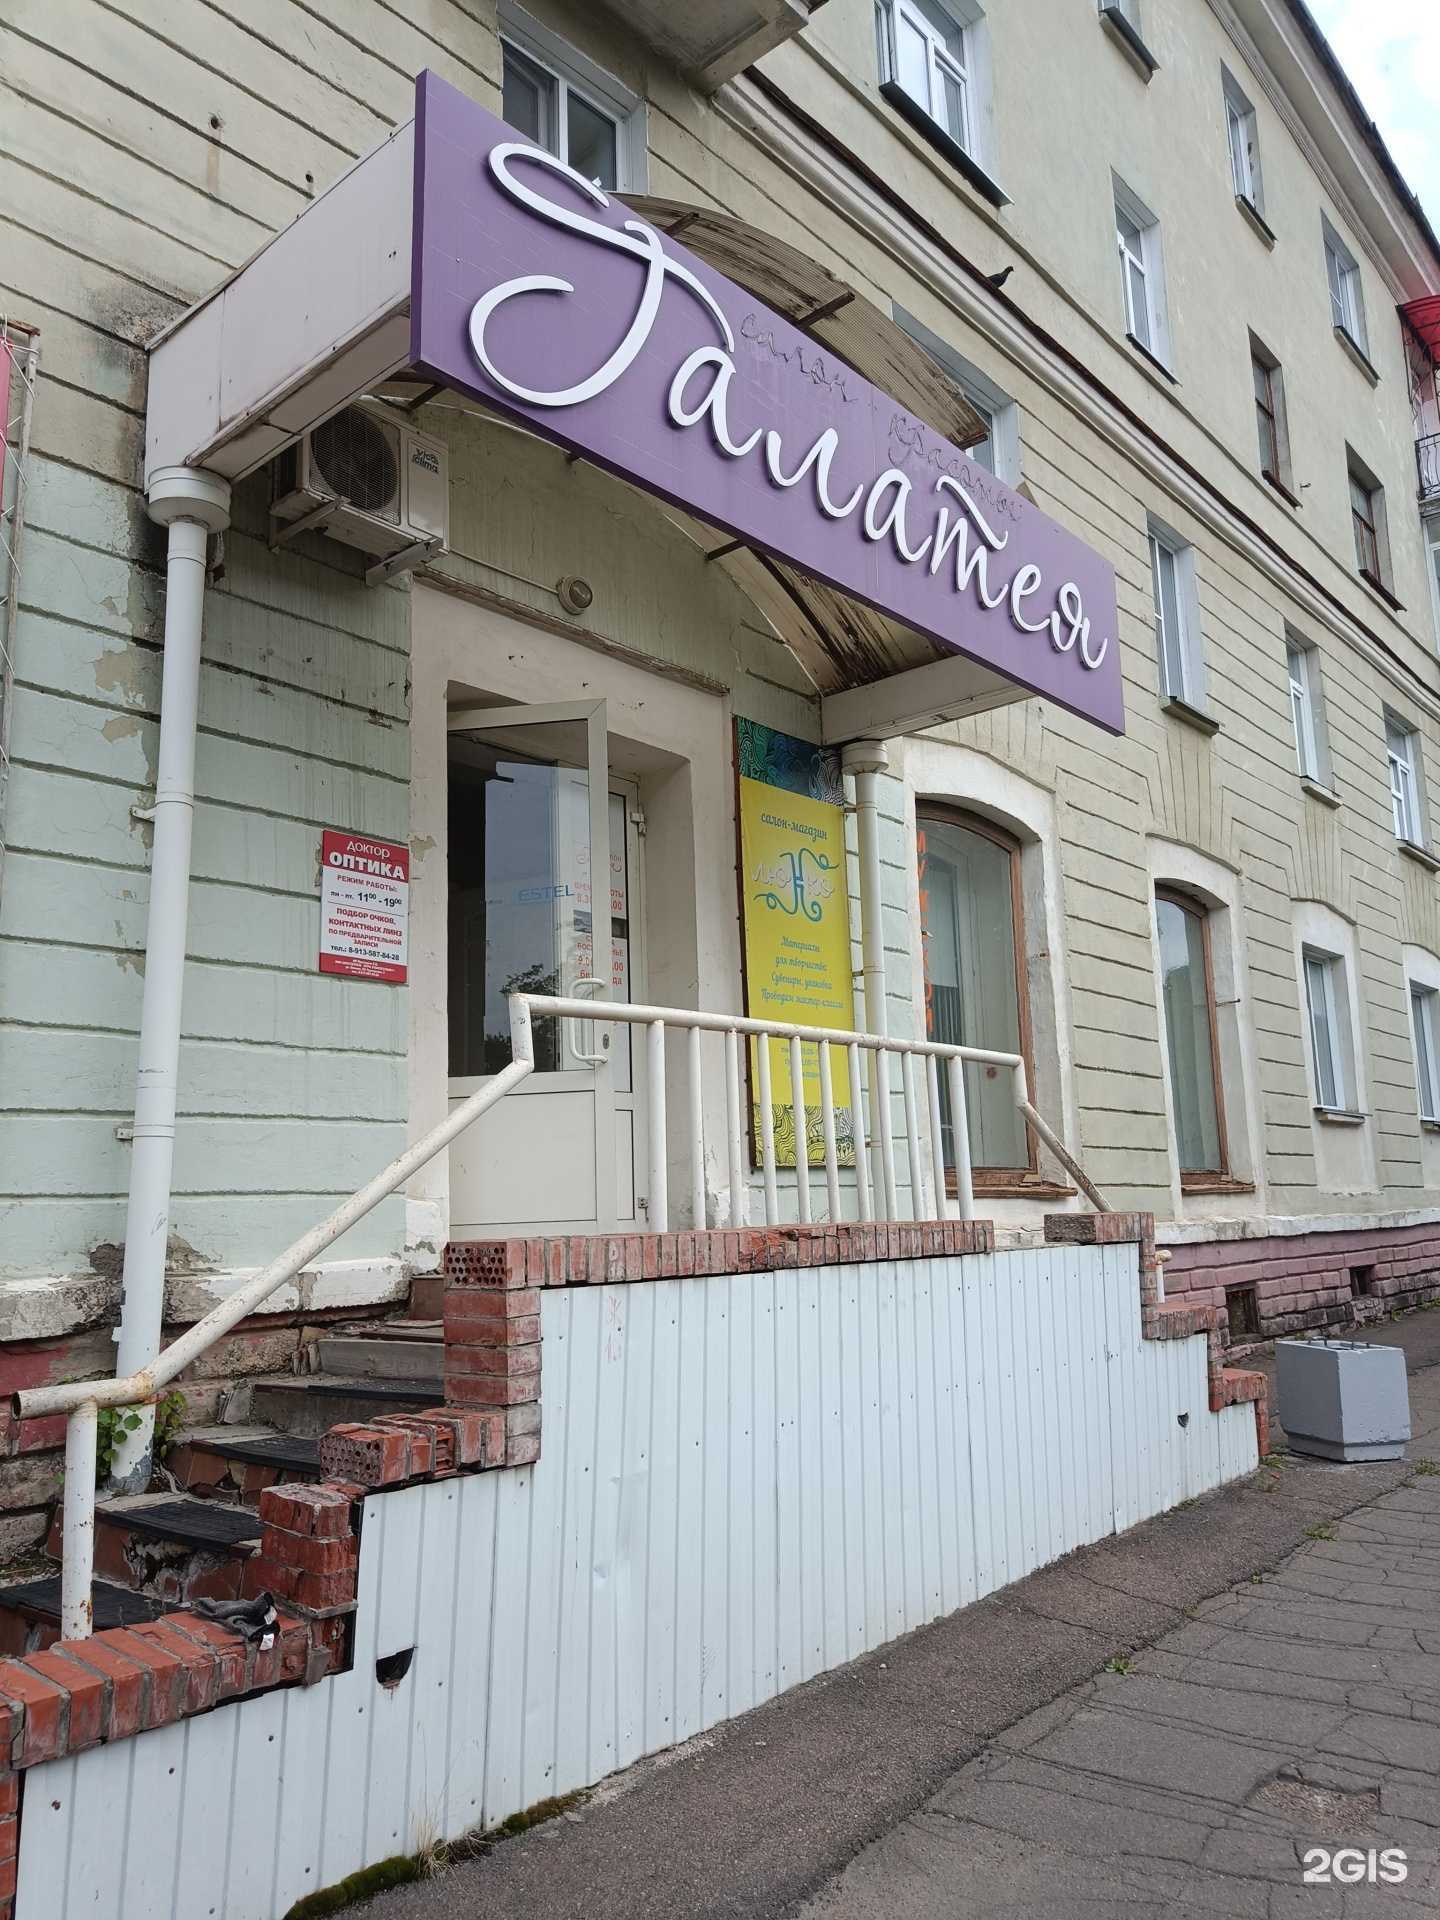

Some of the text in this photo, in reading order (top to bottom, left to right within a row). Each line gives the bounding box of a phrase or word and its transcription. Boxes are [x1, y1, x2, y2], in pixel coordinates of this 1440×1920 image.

[469, 143, 1107, 669] Галатея
[761, 813, 827, 842] салон-магазин
[329, 851, 405, 880] ОПТИКА
[337, 875, 364, 886] РЕЖИМ
[519, 885, 575, 901] ESTEL
[336, 908, 368, 919] ПОДБОР
[328, 918, 402, 936] КОНТАКТНЫХ ЛИНЗ
[339, 929, 402, 946] ПРЕДВАРИТЕЛЬНОЙ
[353, 940, 378, 948] ЗАПИСИ
